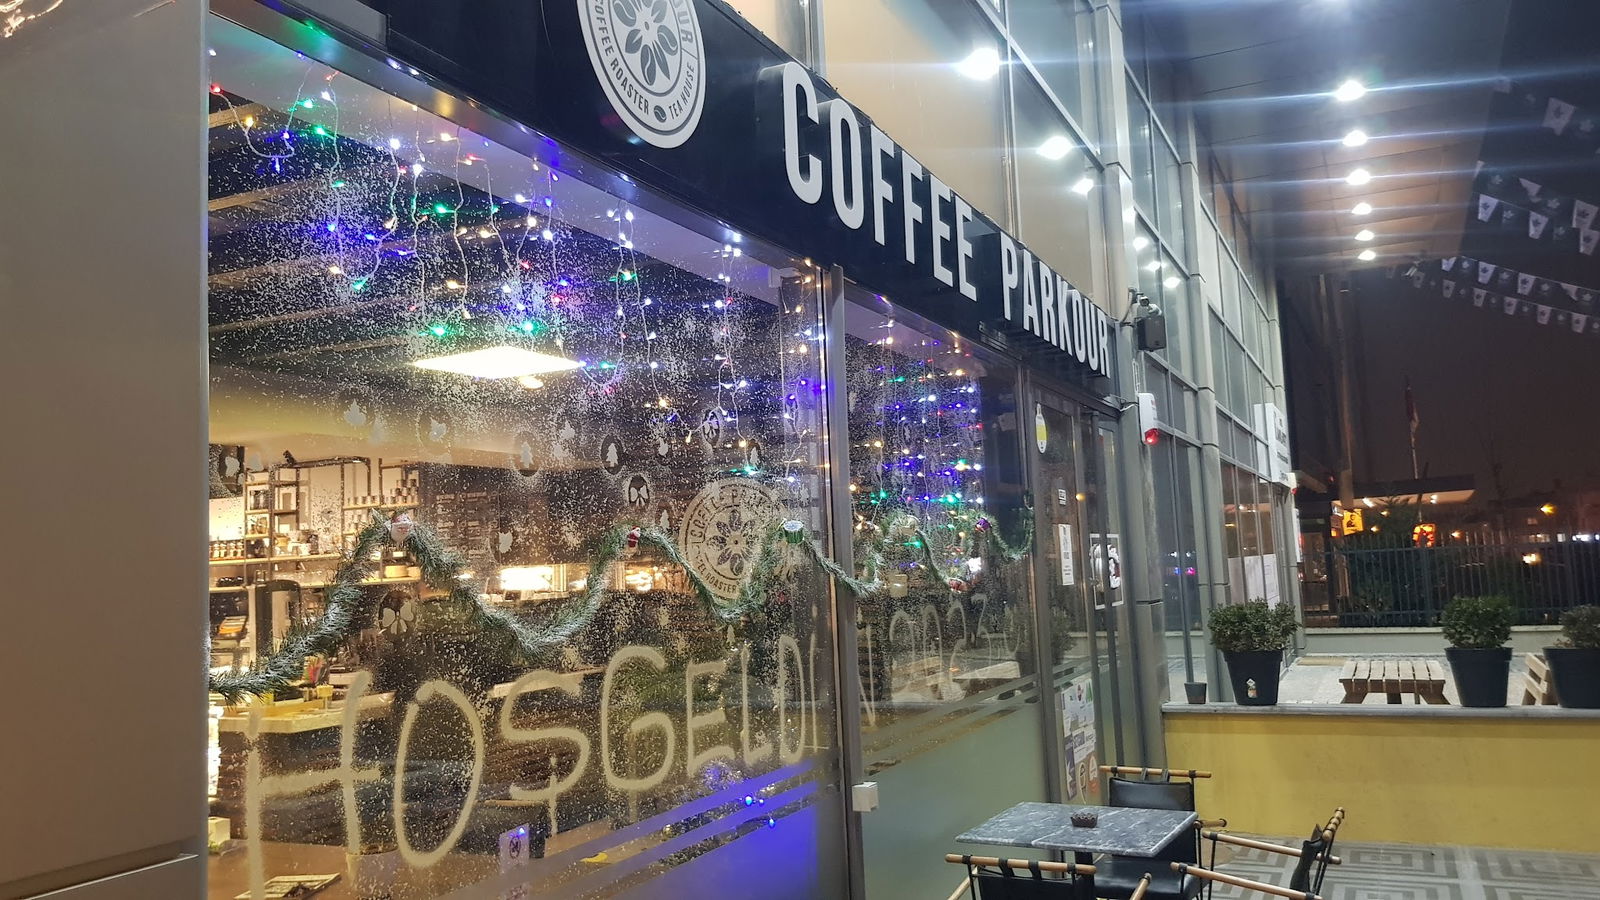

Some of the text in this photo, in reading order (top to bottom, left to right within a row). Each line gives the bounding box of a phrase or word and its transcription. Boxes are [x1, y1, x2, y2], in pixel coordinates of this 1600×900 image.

[610, 58, 649, 116] ROASTER
[668, 63, 695, 121] TEA HOUSE
[781, 61, 1111, 379] COFFEE PARKOUR
